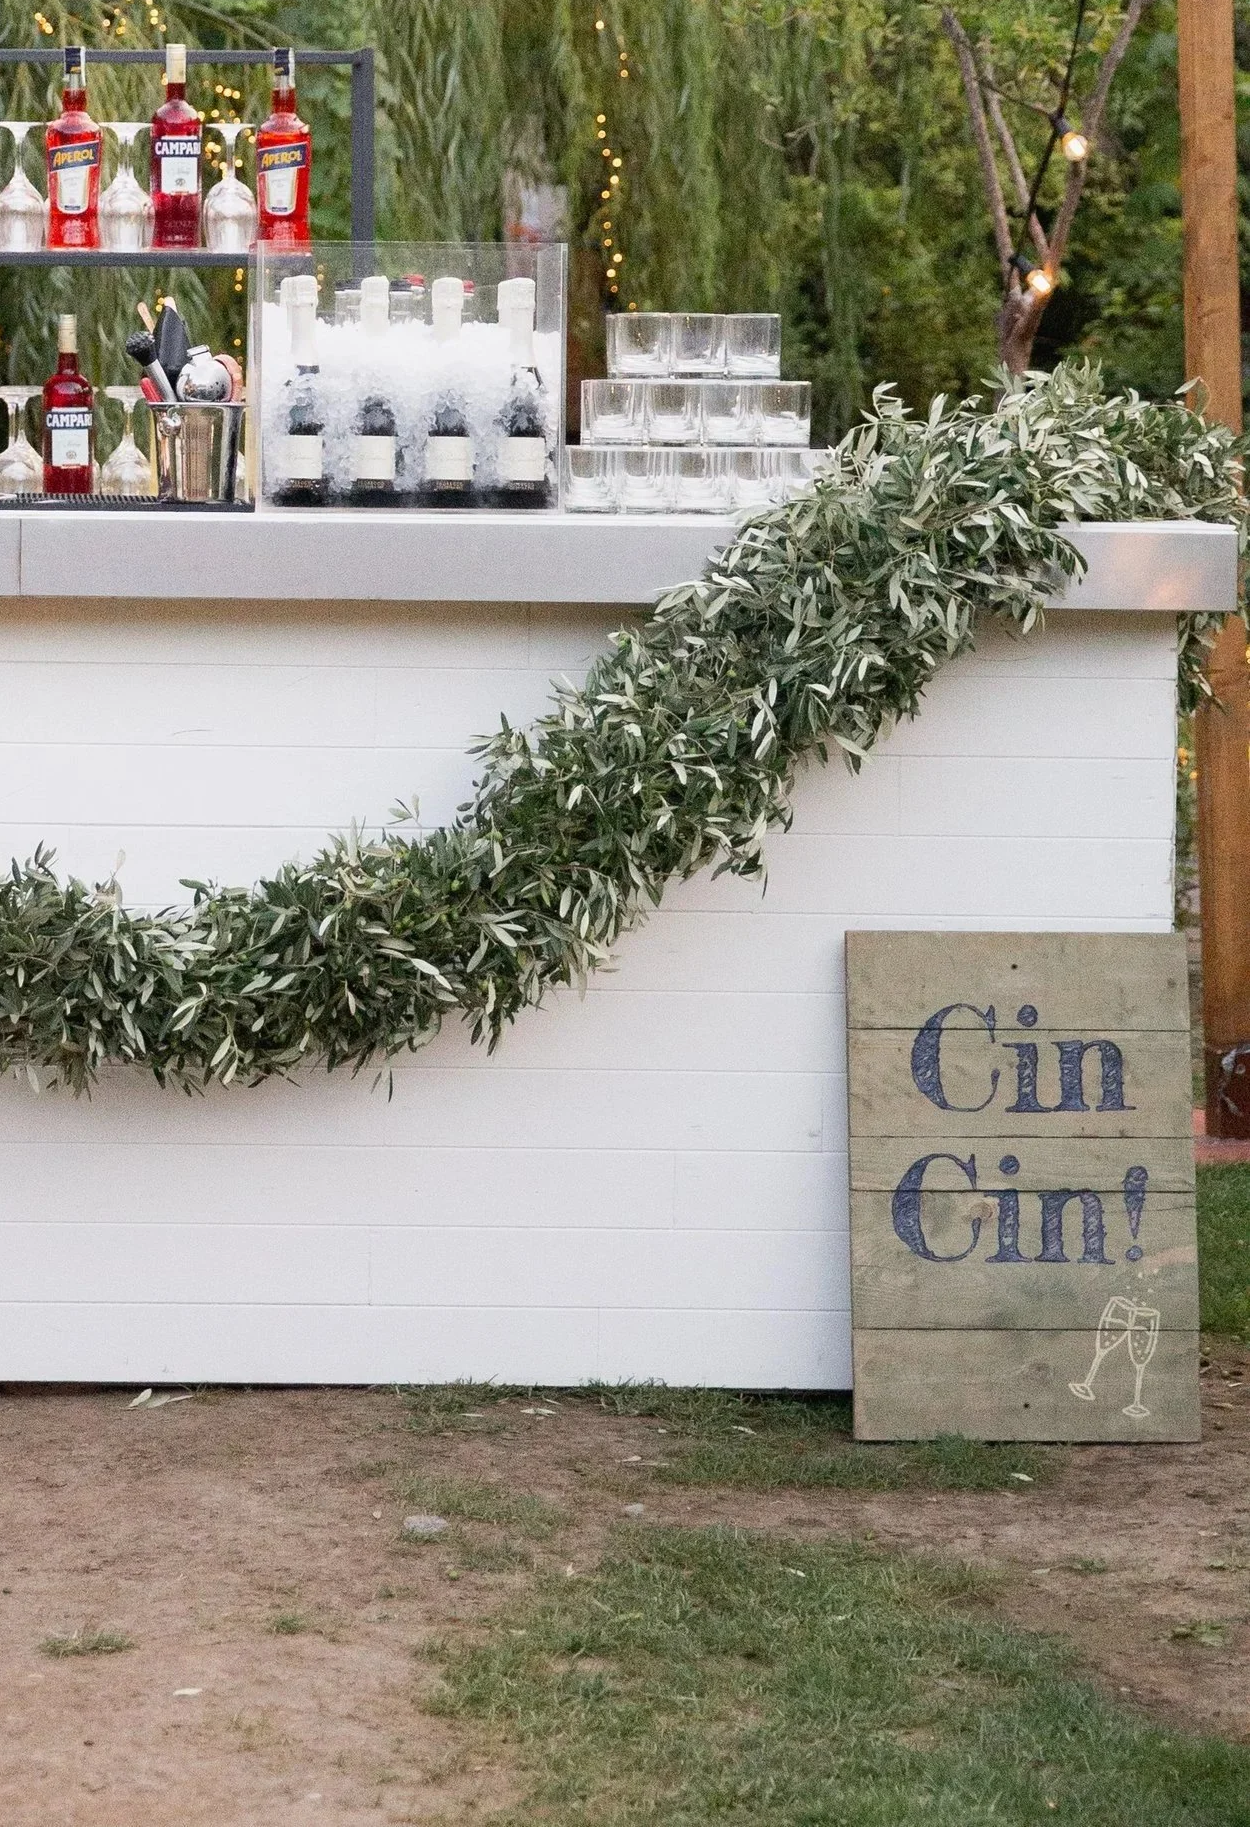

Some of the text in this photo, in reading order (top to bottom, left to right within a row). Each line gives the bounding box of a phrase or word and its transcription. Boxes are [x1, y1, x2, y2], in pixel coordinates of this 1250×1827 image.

[52, 148, 95, 167] APEROL
[261, 149, 303, 168] APEROL
[910, 1003, 1137, 1113] Cin
[891, 1152, 1149, 1265] Cin!
